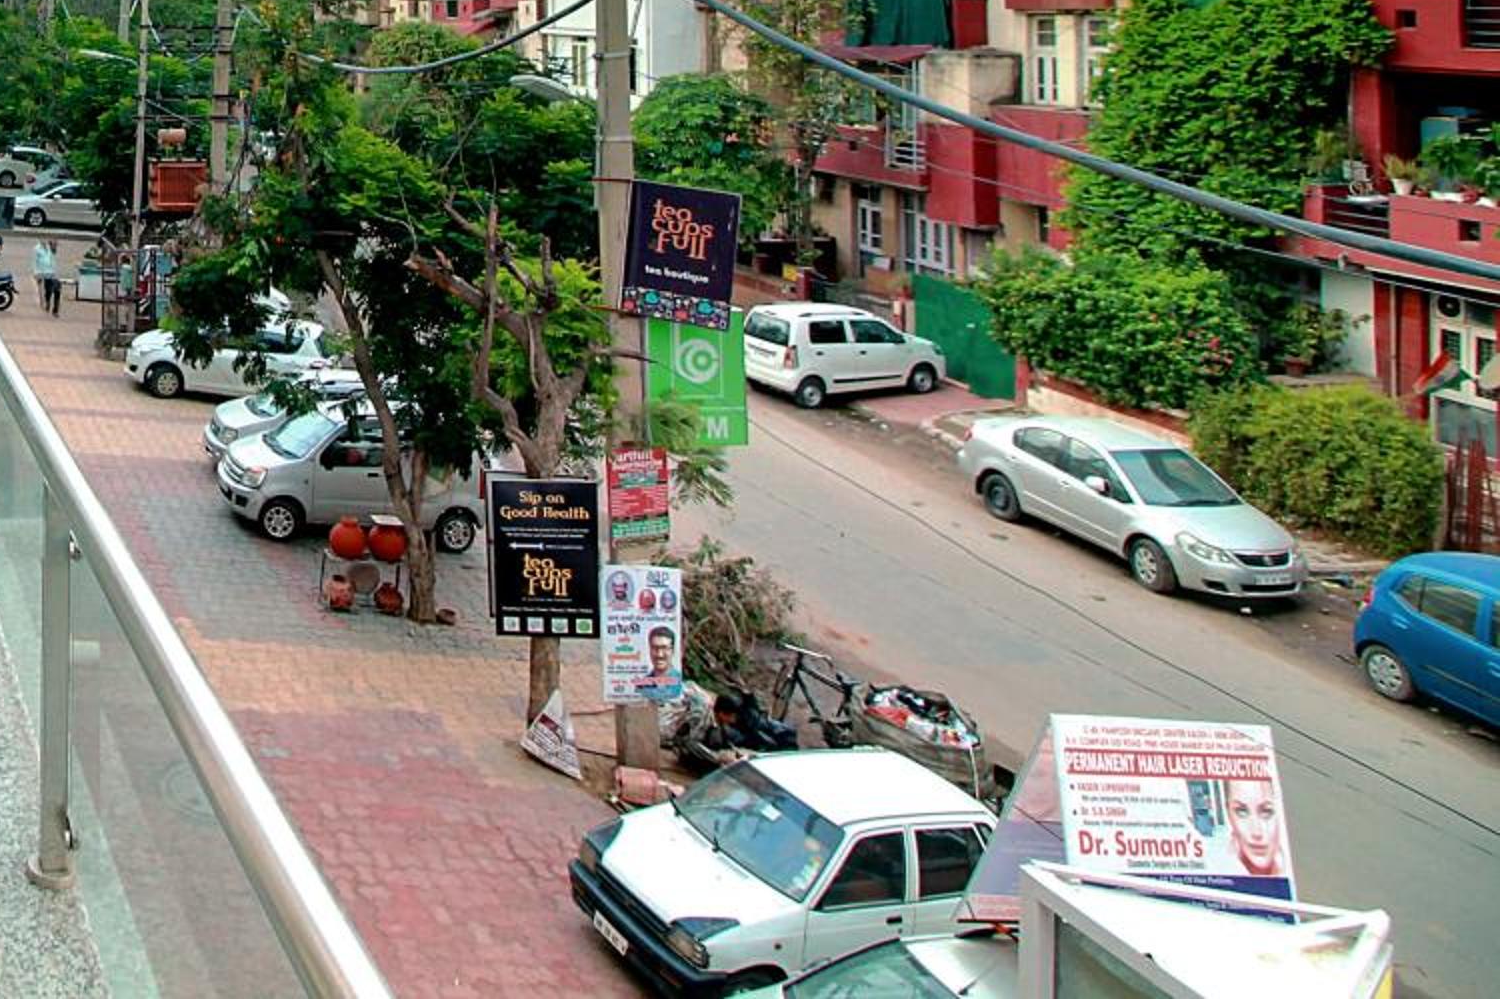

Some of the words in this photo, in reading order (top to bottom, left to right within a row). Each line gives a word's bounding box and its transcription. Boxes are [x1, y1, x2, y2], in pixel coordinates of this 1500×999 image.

[663, 267, 709, 284] boutique
[519, 490, 542, 504] Sip
[545, 494, 565, 504] on
[500, 505, 537, 520] Good
[543, 506, 590, 520] Health
[1065, 752, 1135, 773] PERMANENT
[1137, 755, 1167, 775] HAIR
[1168, 756, 1203, 776] LASER
[1205, 757, 1270, 778] REDUCTION
[1079, 830, 1109, 856] Dr.
[1115, 830, 1203, 858] Suman's
